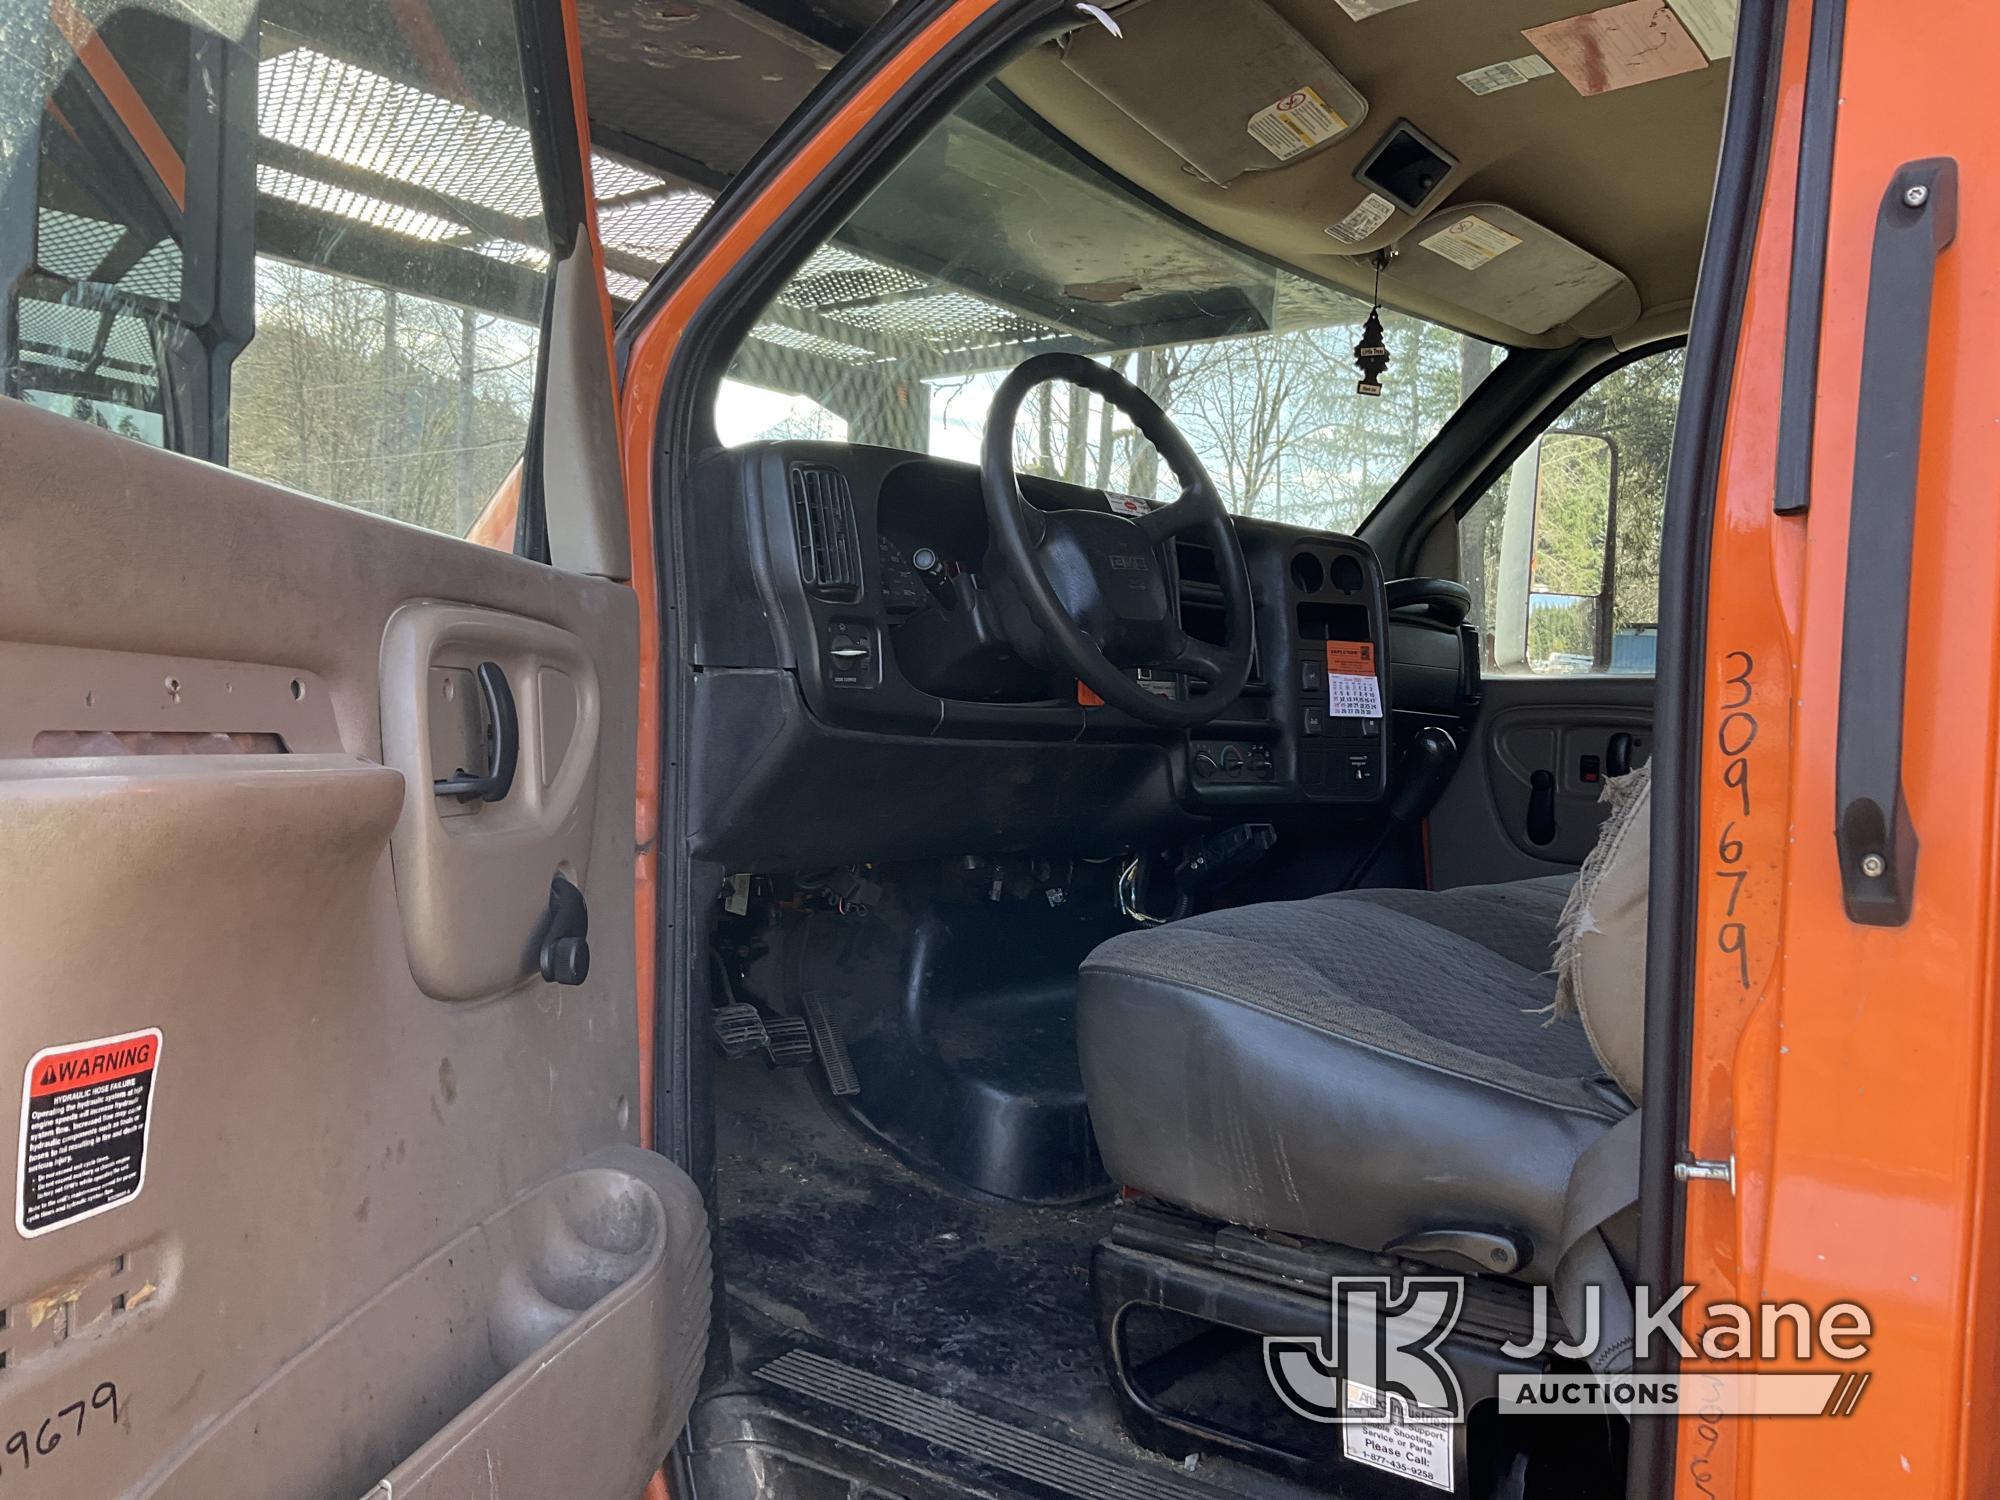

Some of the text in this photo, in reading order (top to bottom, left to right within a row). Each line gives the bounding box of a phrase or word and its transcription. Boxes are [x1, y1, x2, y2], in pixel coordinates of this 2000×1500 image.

[1715, 651, 1758, 990] 309679
[58, 1044, 150, 1082] WARNING
[32, 1107, 64, 1119] Operating
[105, 1092, 126, 1102] system
[54, 1078, 135, 1104] HYDRAULIC HOSE FAILURE
[31, 1120, 54, 1130] engine
[55, 1114, 77, 1124] speeds
[0, 1382, 118, 1476] 9679
[1362, 1426, 1394, 1443] Service
[1410, 1442, 1432, 1456] Parts
[1362, 1450, 1434, 1480] 1-877-435-9258
[1365, 1438, 1430, 1467] Please Call:
